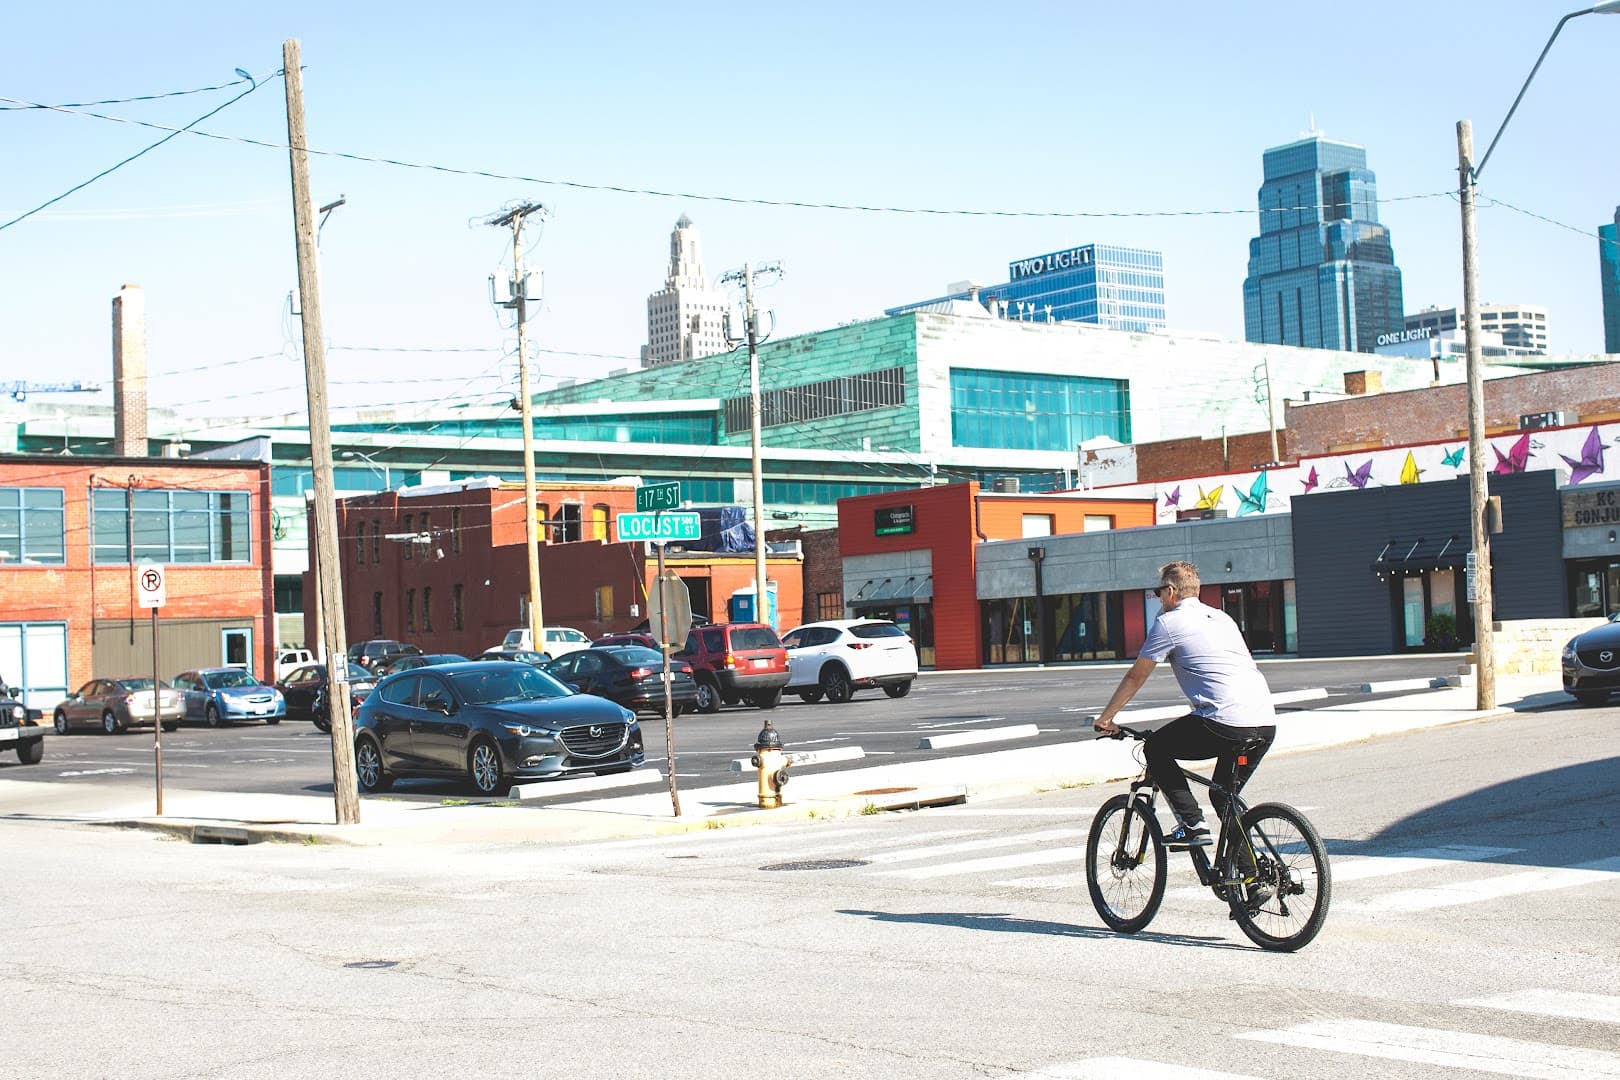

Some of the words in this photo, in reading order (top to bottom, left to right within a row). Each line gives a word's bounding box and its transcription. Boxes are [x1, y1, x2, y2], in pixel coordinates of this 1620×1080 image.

[1010, 258, 1044, 278] TWO
[1046, 247, 1092, 271] LIGHT
[1377, 332, 1399, 346] ONE
[1401, 327, 1431, 342] LIGHT
[638, 495, 643, 505] E
[666, 487, 678, 505] ST
[1597, 491, 1615, 506] KC
[620, 516, 681, 536] LOCUST
[685, 525, 695, 536] ST
